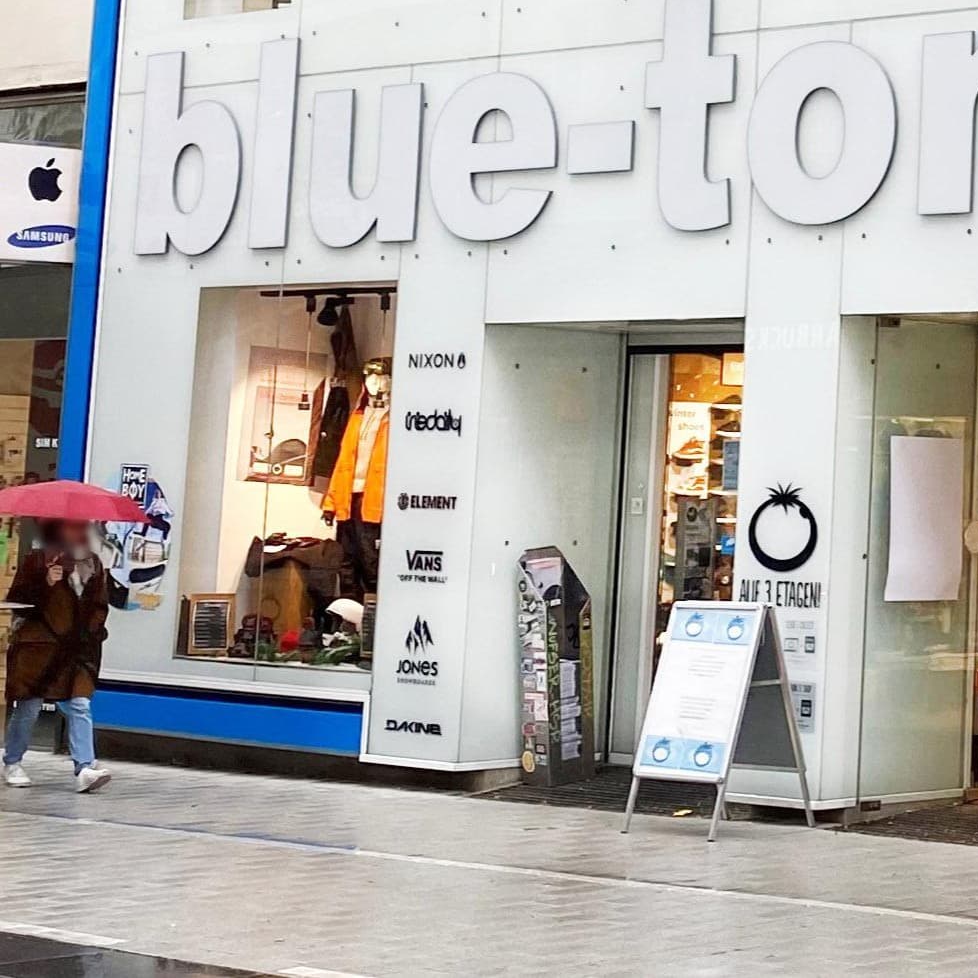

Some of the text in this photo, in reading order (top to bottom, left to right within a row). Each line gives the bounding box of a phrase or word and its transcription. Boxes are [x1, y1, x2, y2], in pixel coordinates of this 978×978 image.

[16, 230, 70, 242] SAMSUNG
[408, 353, 455, 369] NIXON
[410, 495, 457, 510] ELEMENT
[406, 550, 444, 572] VANS
[775, 580, 822, 609] ETAGEN!
[384, 719, 442, 736] DAKINE
